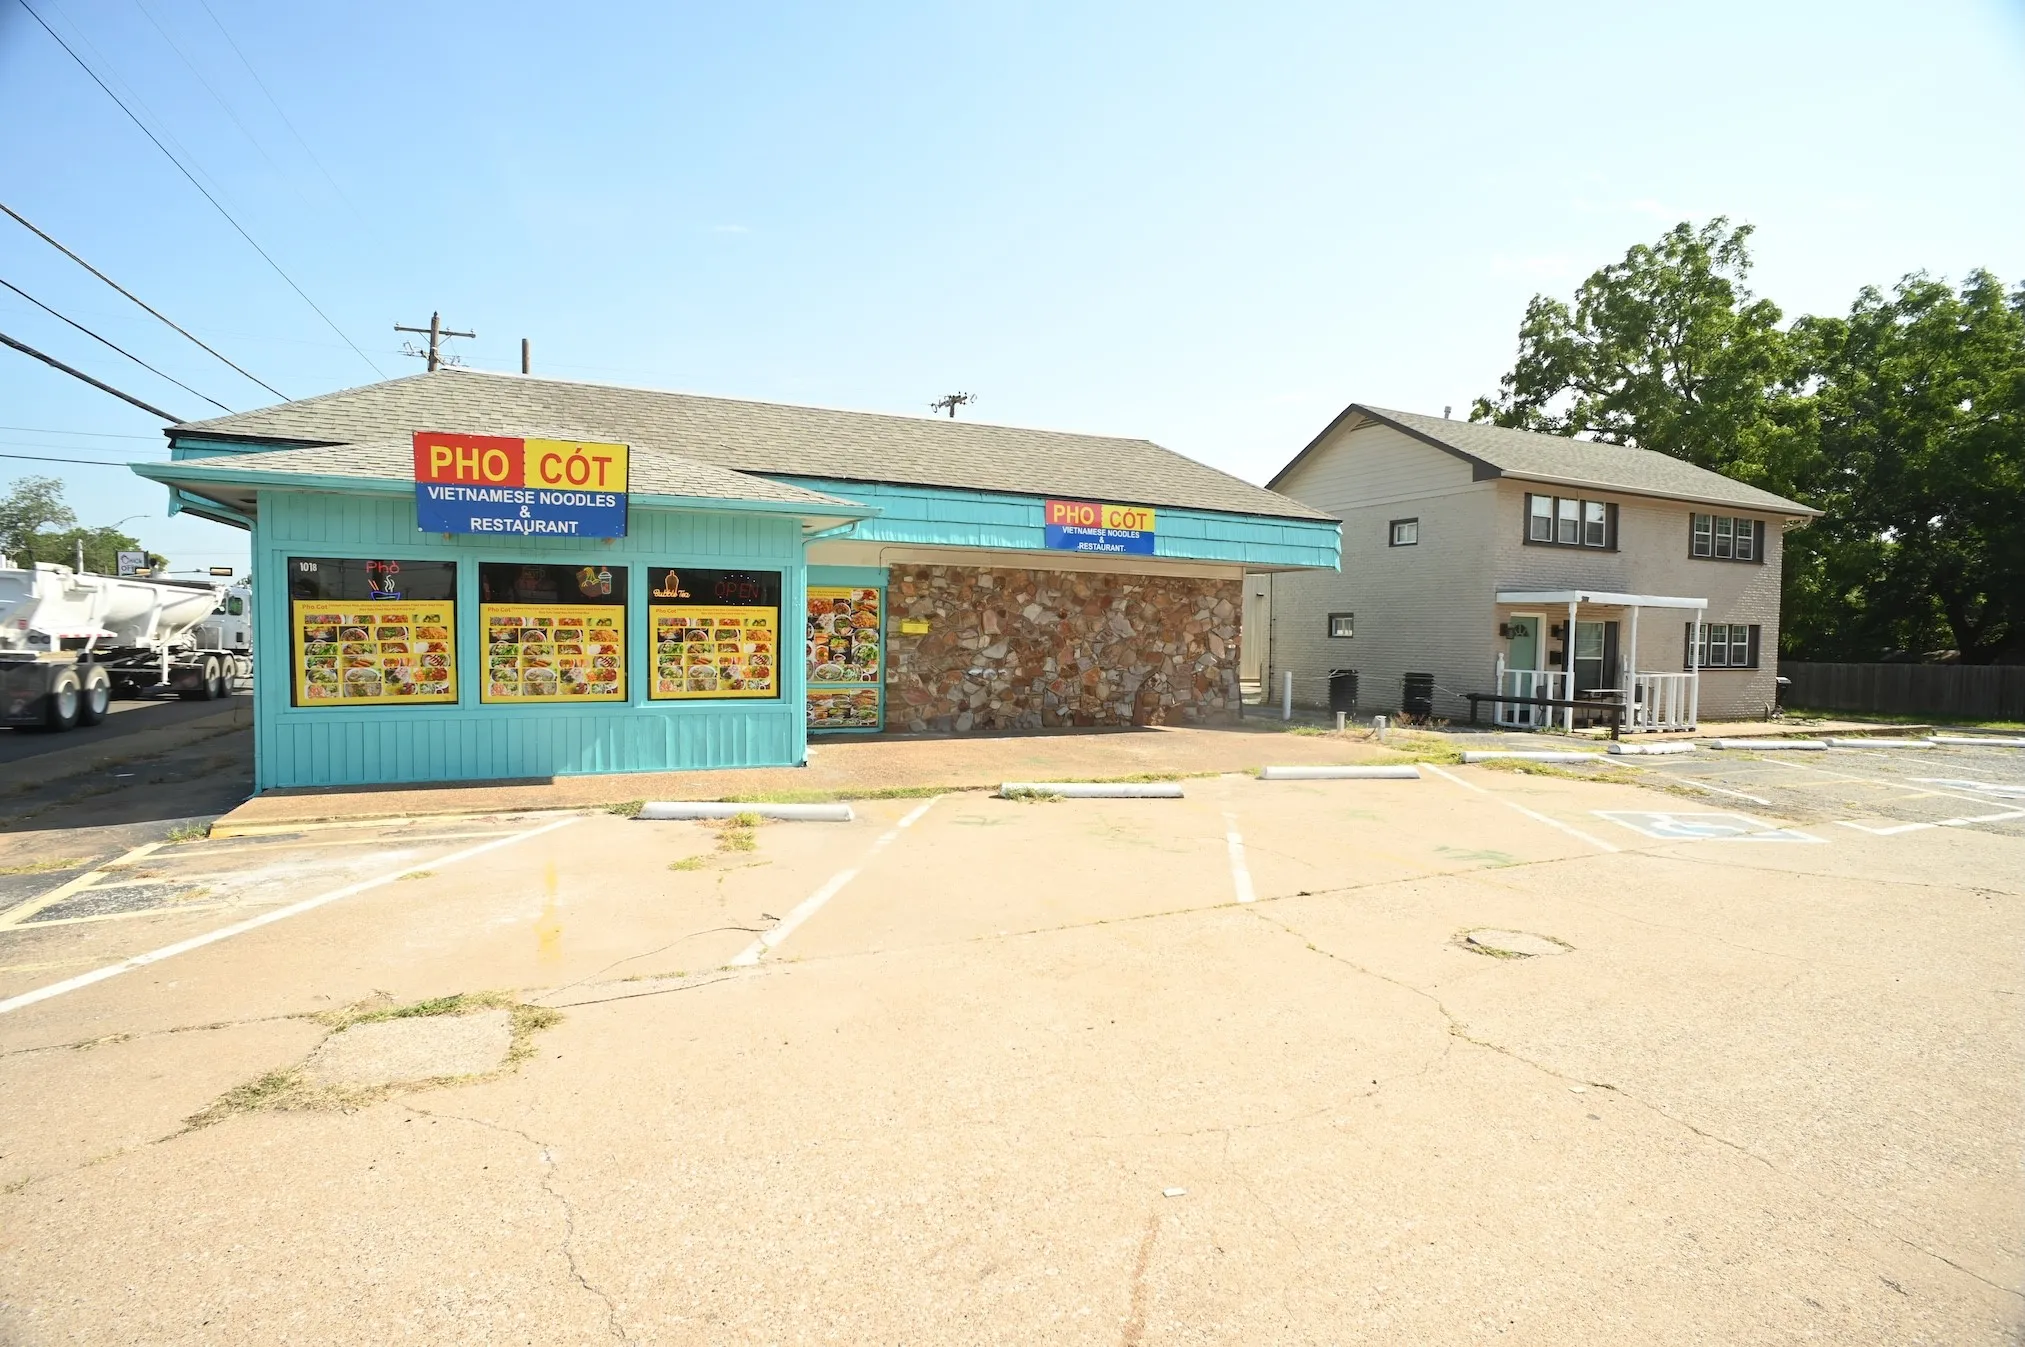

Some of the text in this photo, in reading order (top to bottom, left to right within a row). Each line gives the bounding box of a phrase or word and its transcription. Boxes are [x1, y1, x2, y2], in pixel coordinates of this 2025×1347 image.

[430, 445, 613, 487] PHO CÓT
[427, 486, 616, 508] VIETNAMESE NOODLES
[519, 505, 531, 518] &
[1053, 504, 1147, 530] PHO CÓT
[471, 518, 578, 534] RESTAURANT
[1062, 526, 1139, 538] VIETNAMESE NOODLES
[1079, 542, 1124, 551] RESTAURANT
[299, 562, 318, 572] 1018
[653, 588, 691, 598] Bubble Tea
[715, 582, 759, 598] OPEN
